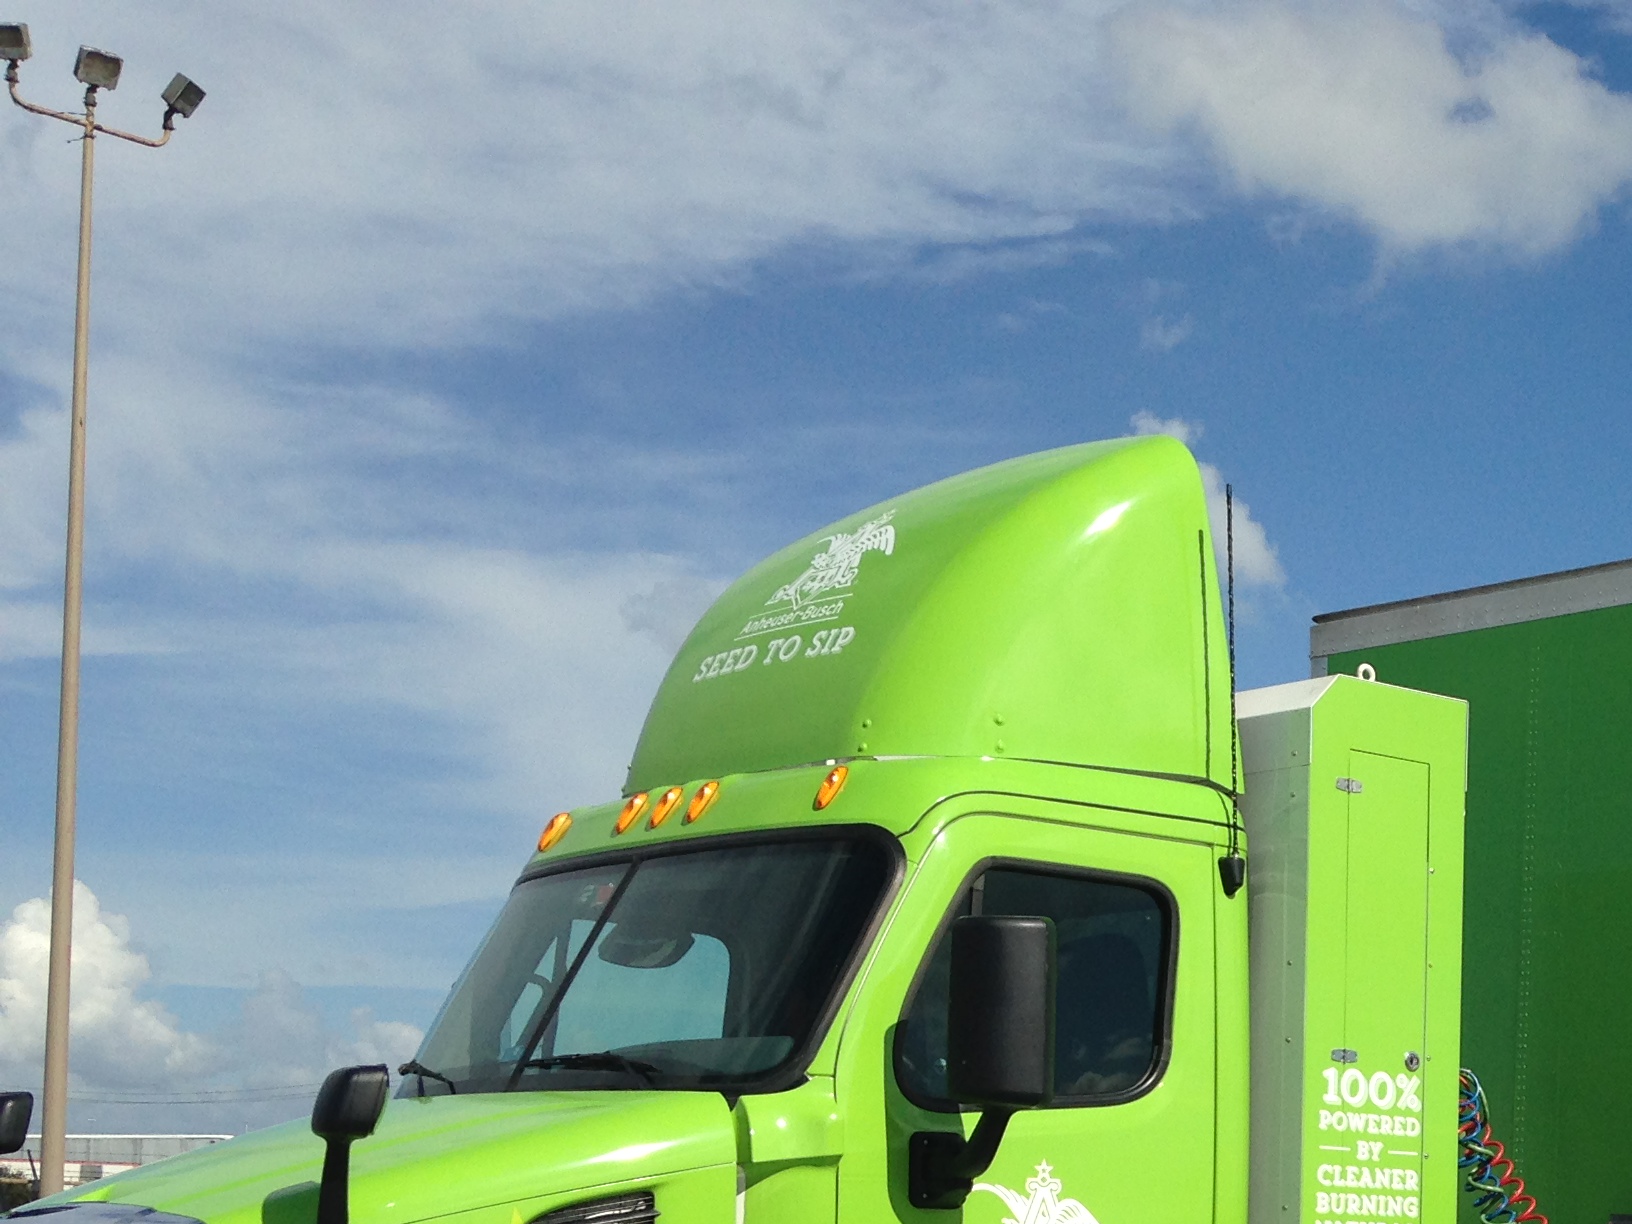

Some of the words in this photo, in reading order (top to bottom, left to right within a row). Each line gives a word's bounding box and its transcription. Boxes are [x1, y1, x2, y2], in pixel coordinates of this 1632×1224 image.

[740, 600, 844, 635] Anheuser-Busch
[692, 644, 758, 682] SEED
[763, 635, 802, 666] TO
[805, 626, 856, 658] SIP
[1322, 1067, 1422, 1113] 100%
[1319, 1109, 1421, 1137] POWERED
[1356, 1140, 1384, 1162] BY
[1317, 1163, 1419, 1191] CLEANER
[1315, 1191, 1419, 1219] BURNING
